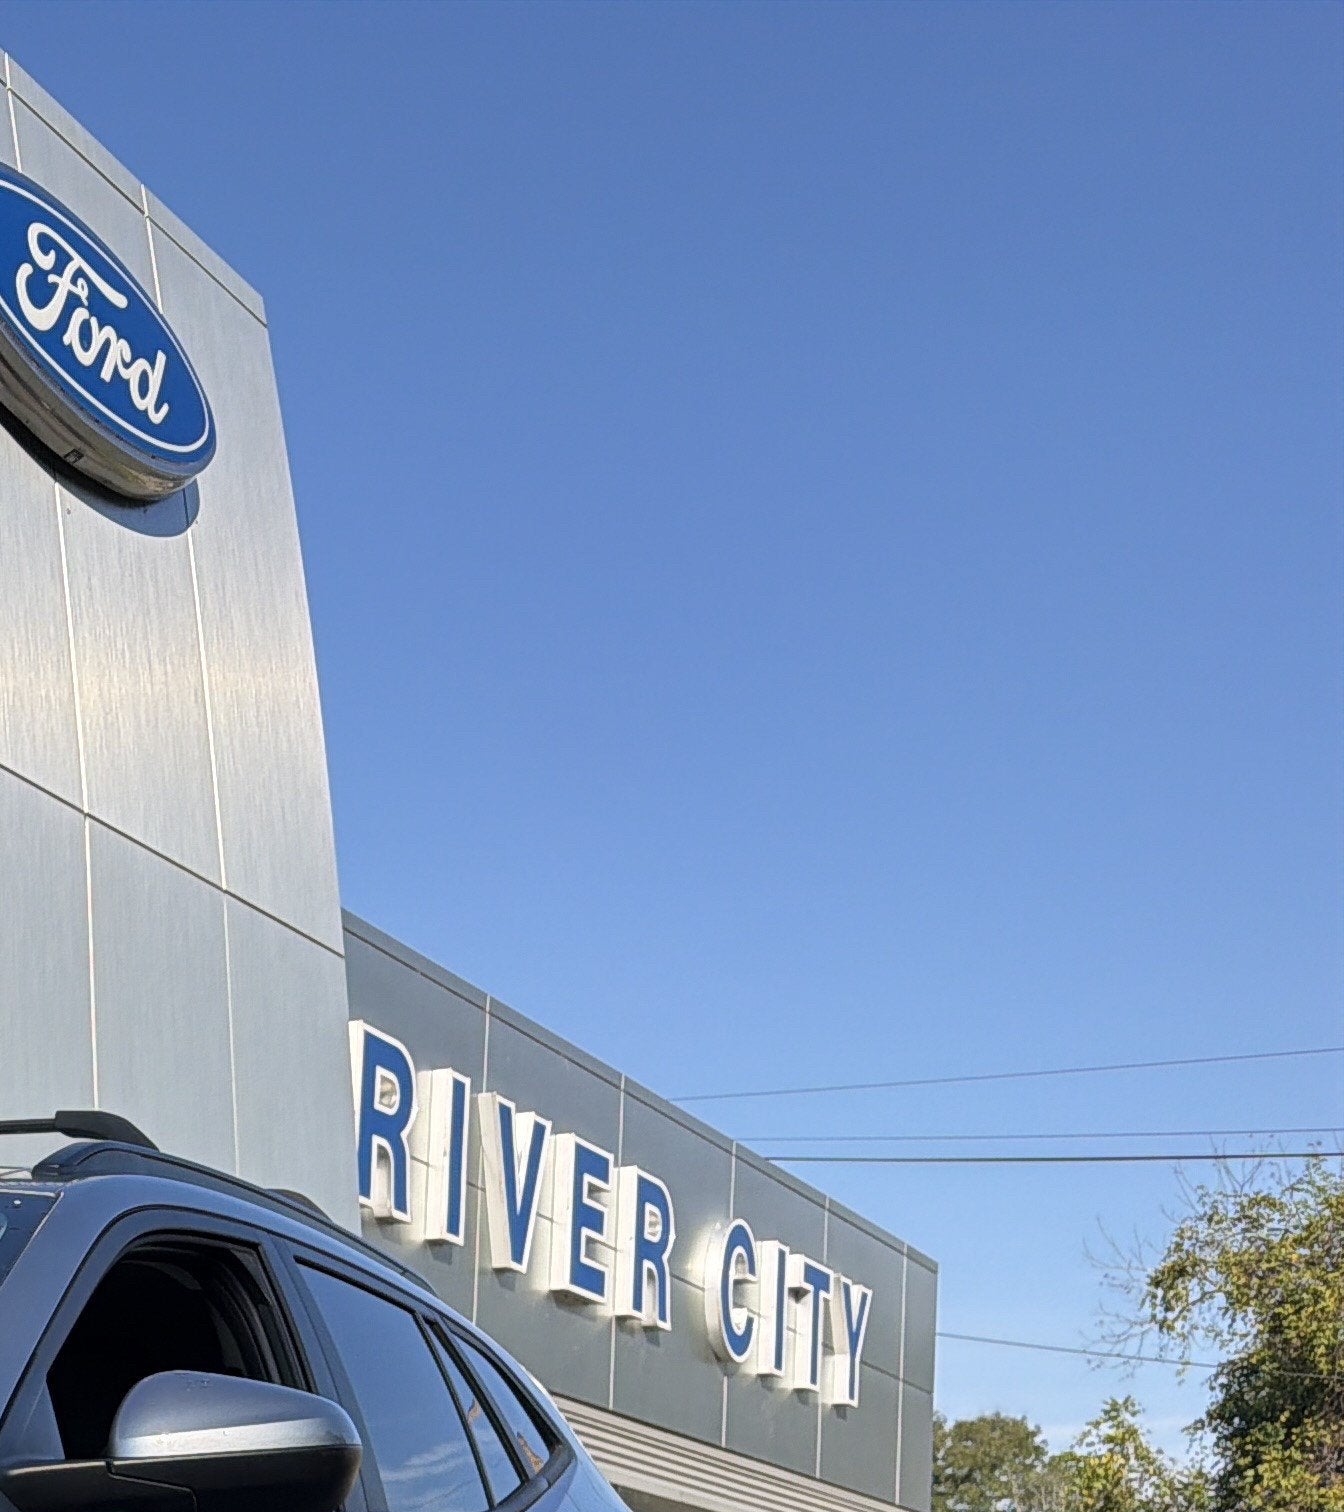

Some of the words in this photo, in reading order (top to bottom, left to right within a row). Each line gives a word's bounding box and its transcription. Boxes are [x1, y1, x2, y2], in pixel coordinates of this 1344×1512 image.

[16, 222, 170, 425] Ford
[349, 1019, 677, 1332] RIVER
[705, 1217, 873, 1408] CITY
